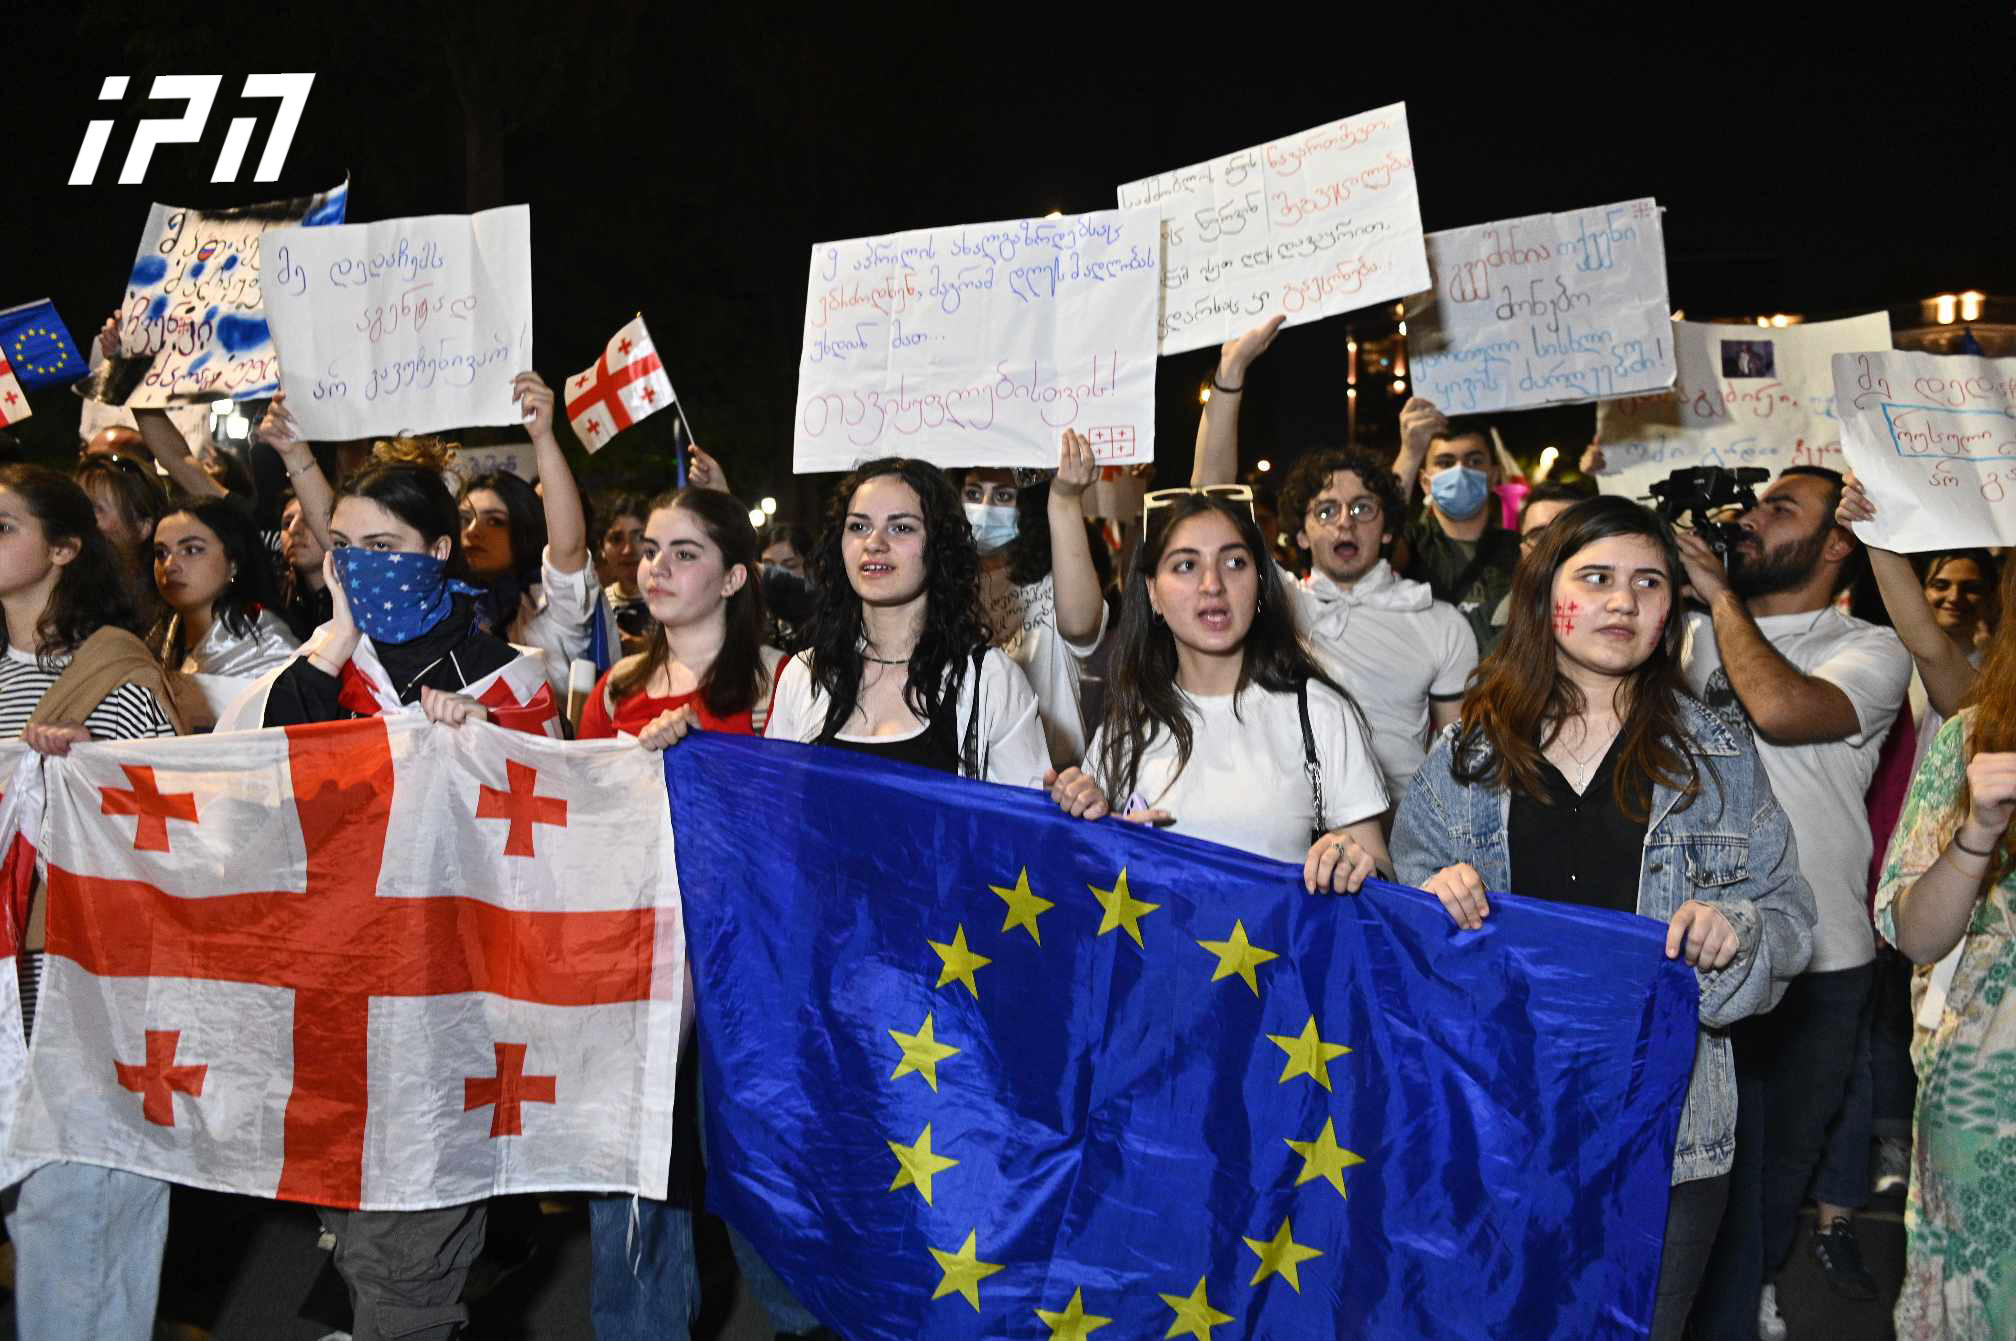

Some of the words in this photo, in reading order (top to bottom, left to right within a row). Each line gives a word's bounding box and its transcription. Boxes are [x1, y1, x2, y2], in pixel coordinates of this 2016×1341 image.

[277, 246, 307, 297] მე
[330, 239, 446, 288] დედაჩემს
[822, 247, 839, 281] 9
[852, 234, 937, 271] აპრილის
[929, 264, 994, 314] მაგრამ
[1071, 246, 1157, 281] მადლობას
[356, 281, 478, 344] აგენტად
[1496, 275, 1591, 333] მონებო
[810, 321, 880, 362] უხდიან
[312, 359, 347, 400] არ
